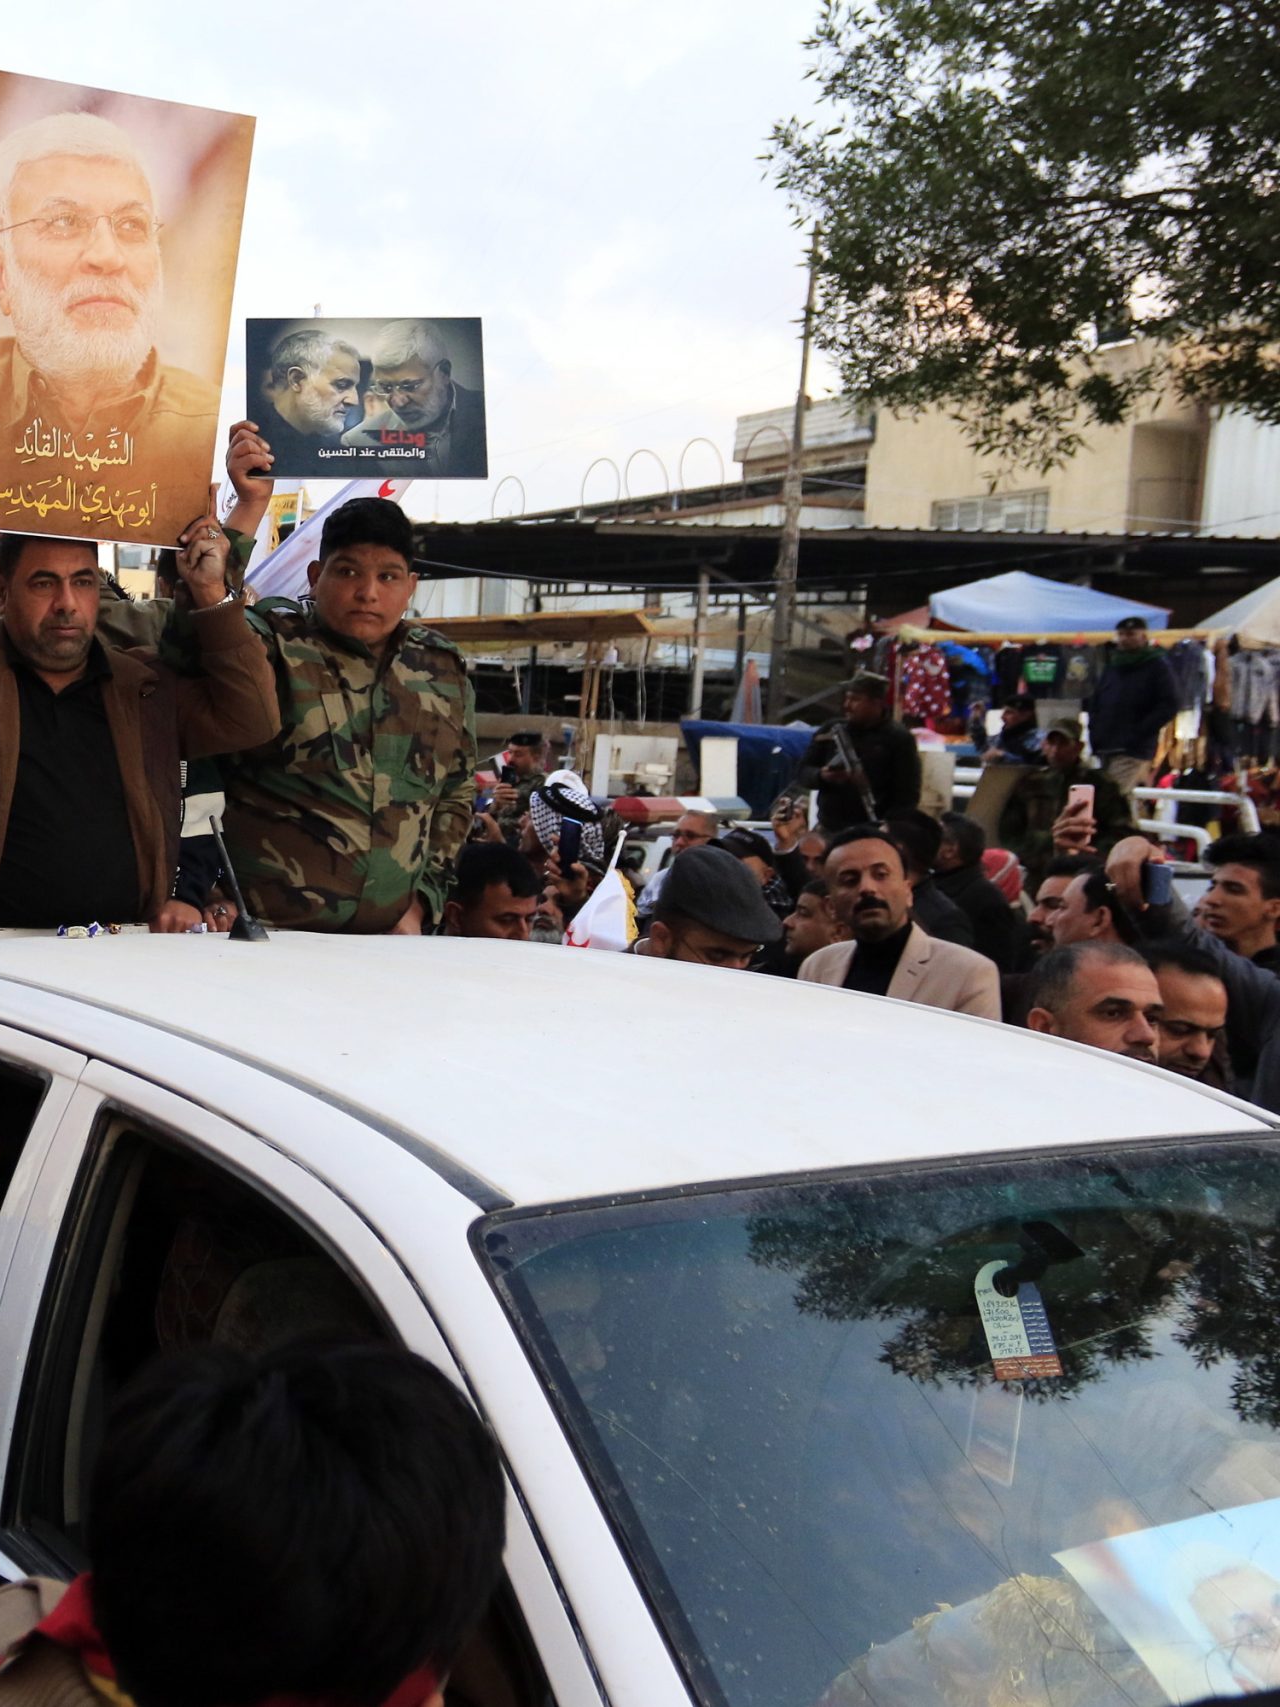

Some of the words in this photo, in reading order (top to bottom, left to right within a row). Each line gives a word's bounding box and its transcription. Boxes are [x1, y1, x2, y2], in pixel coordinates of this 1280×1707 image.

[318, 447, 357, 459] الحسين
[358, 447, 376, 457] عند
[377, 447, 426, 459] والملتقى
